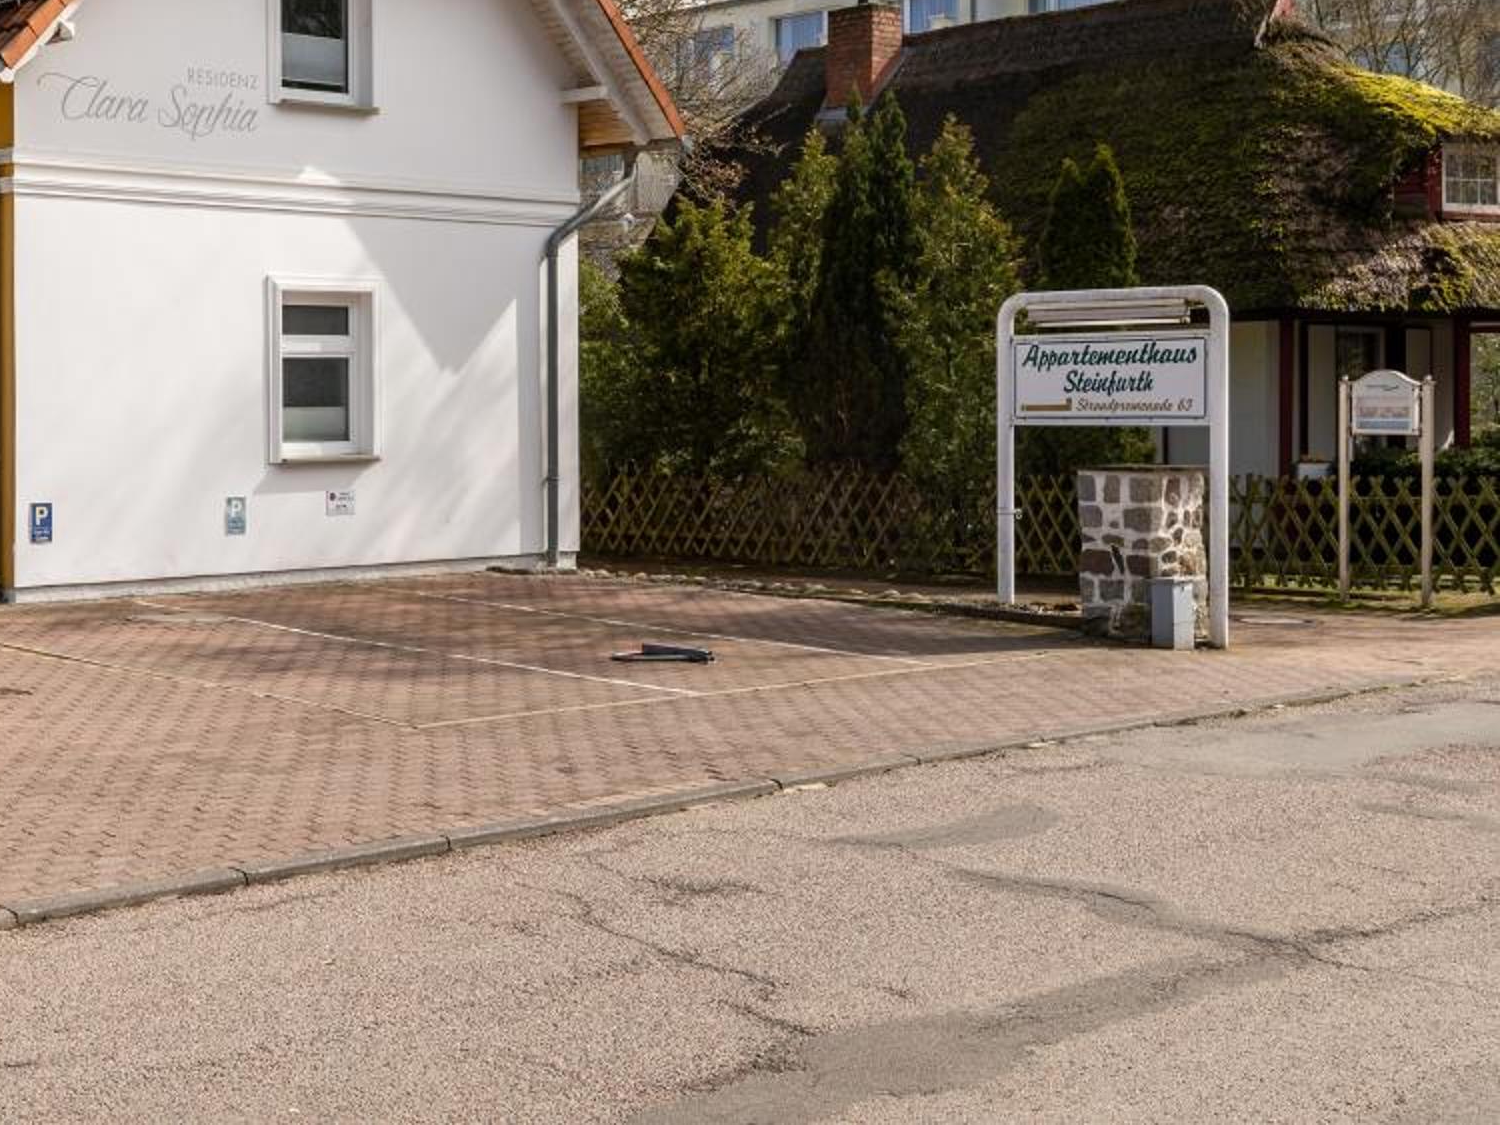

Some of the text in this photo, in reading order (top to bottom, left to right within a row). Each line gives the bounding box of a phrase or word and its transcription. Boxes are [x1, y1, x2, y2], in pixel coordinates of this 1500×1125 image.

[186, 65, 260, 91] RESIDENZ
[36, 72, 259, 142] Clara Sophia
[1022, 342, 1197, 372] Appartementhaus
[1063, 370, 1154, 396] Steinfurth
[1076, 398, 1172, 413] Strandpromenade
[35, 506, 49, 525] P
[230, 500, 242, 517] P
